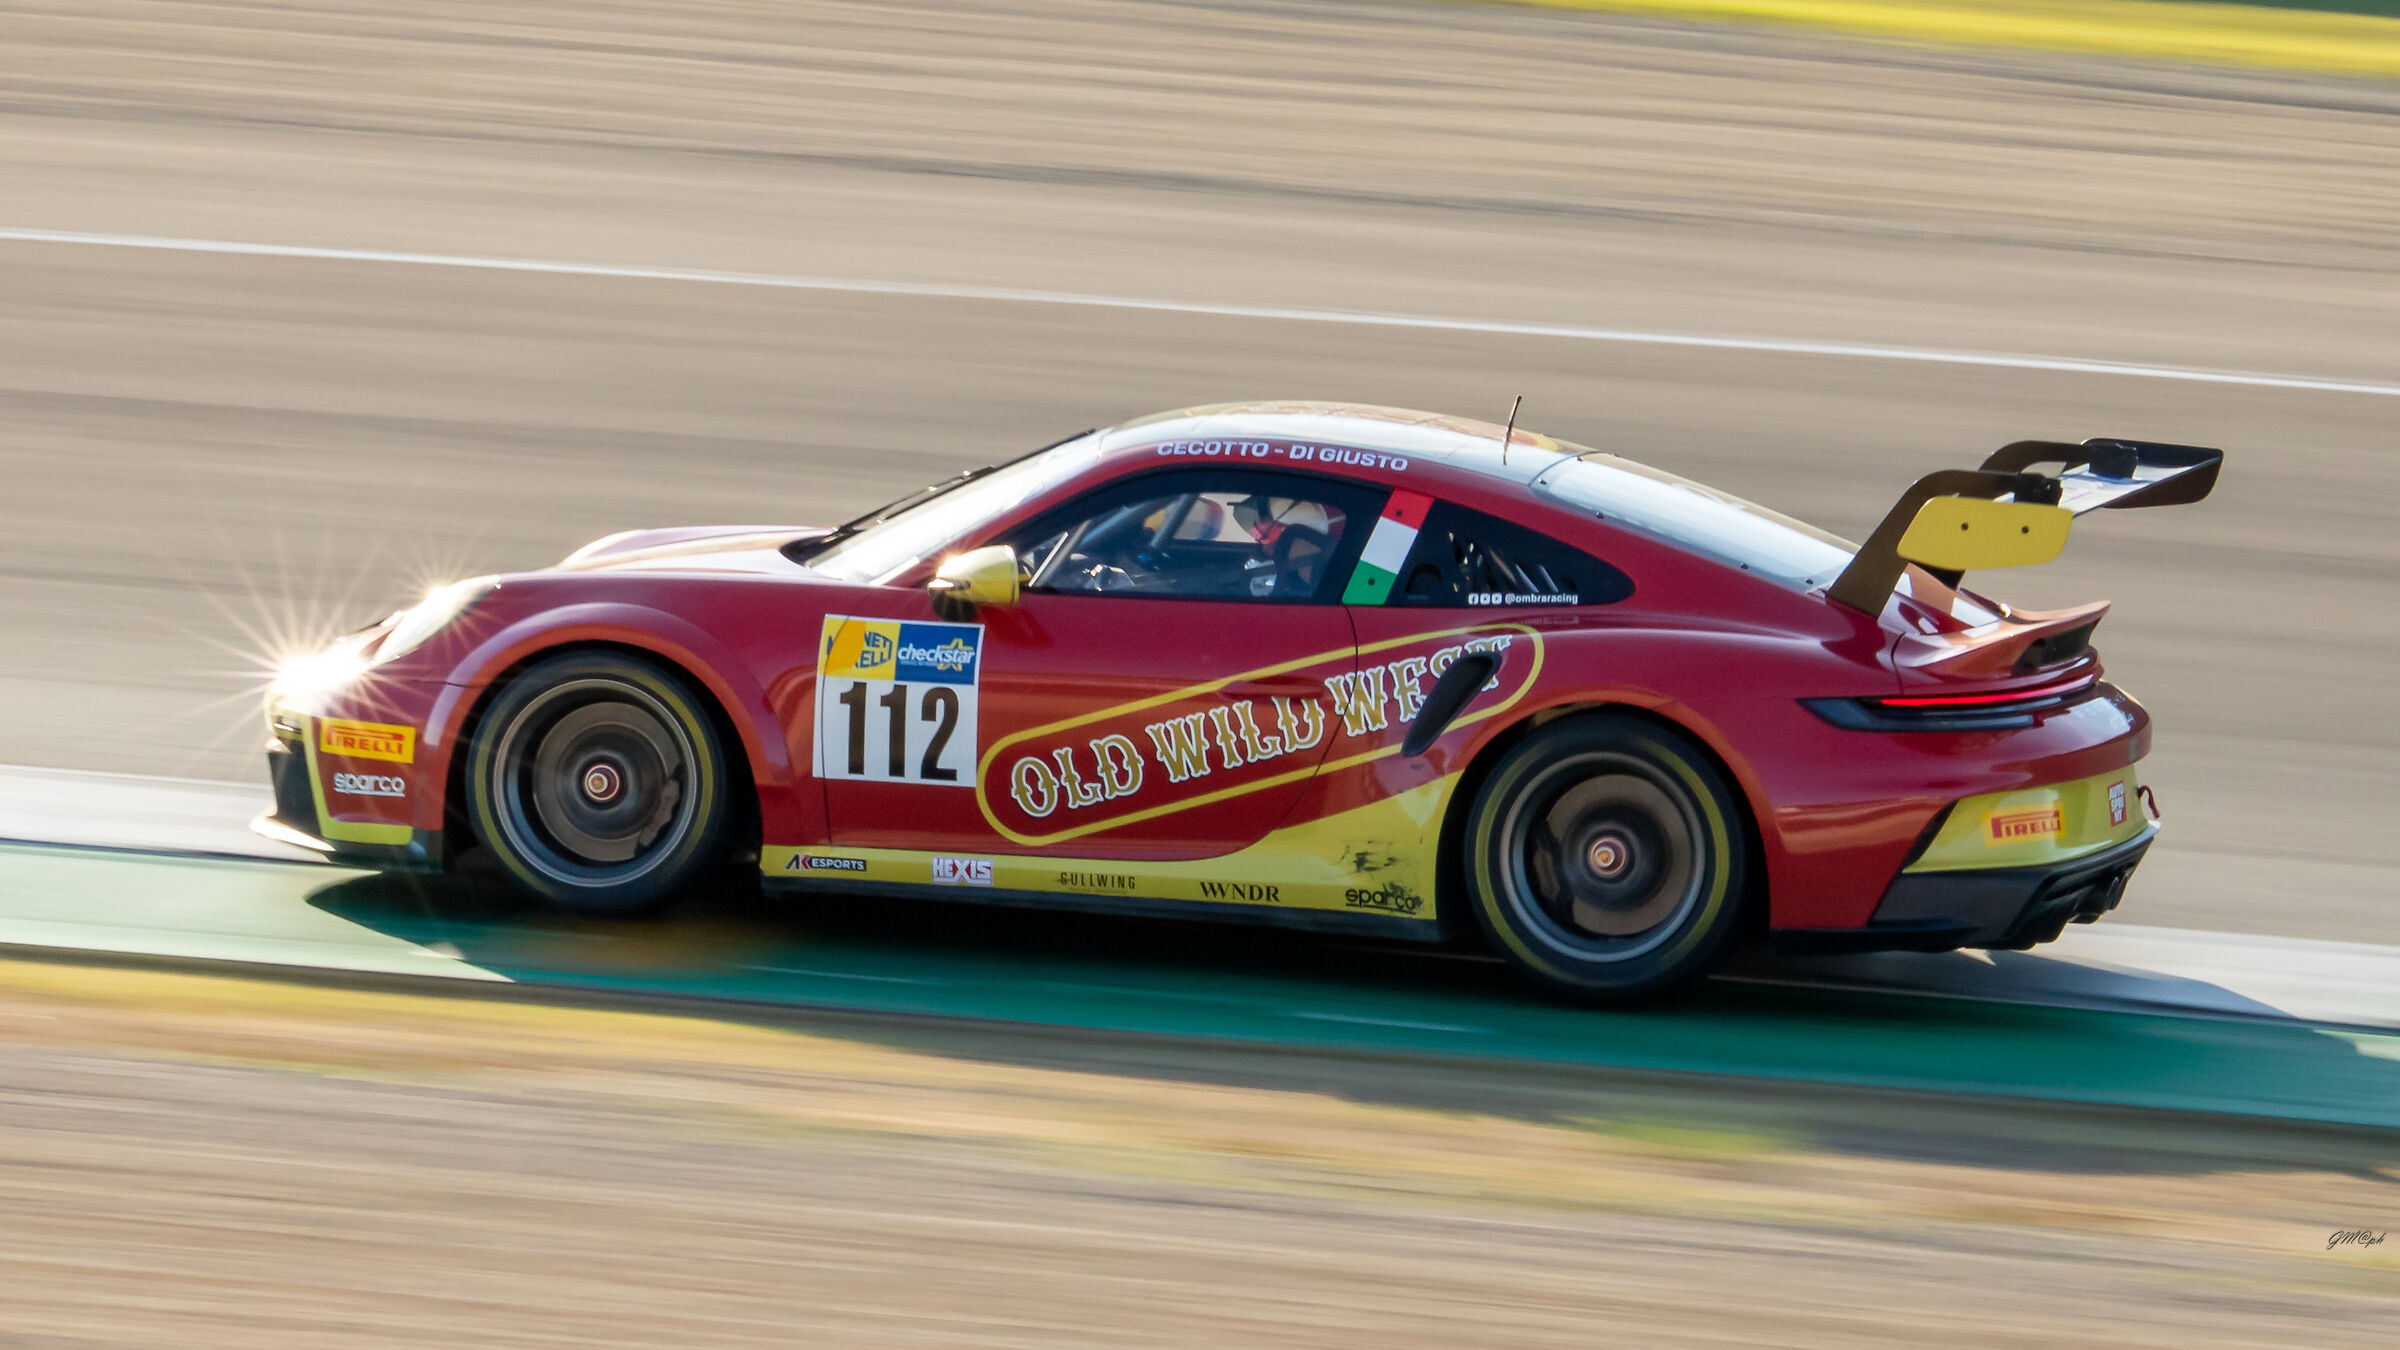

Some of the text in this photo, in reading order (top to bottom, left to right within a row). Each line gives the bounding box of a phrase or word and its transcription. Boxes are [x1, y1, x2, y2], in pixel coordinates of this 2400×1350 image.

[1157, 441, 1269, 458] CECOTTO
[1289, 444, 1315, 461] DI
[1319, 447, 1409, 471] GIUSTO
[1504, 593, 1578, 605] @ombraracing
[898, 643, 975, 664] checkstar
[326, 724, 405, 755] PIRELLI
[840, 681, 960, 782] 112
[1011, 733, 1144, 819] OLD
[1145, 694, 1325, 783] WILD
[333, 772, 405, 797] sparco
[1991, 810, 2061, 839] PIRELLI
[932, 857, 992, 885] HEXIS
[1059, 872, 1136, 889] GULLWING
